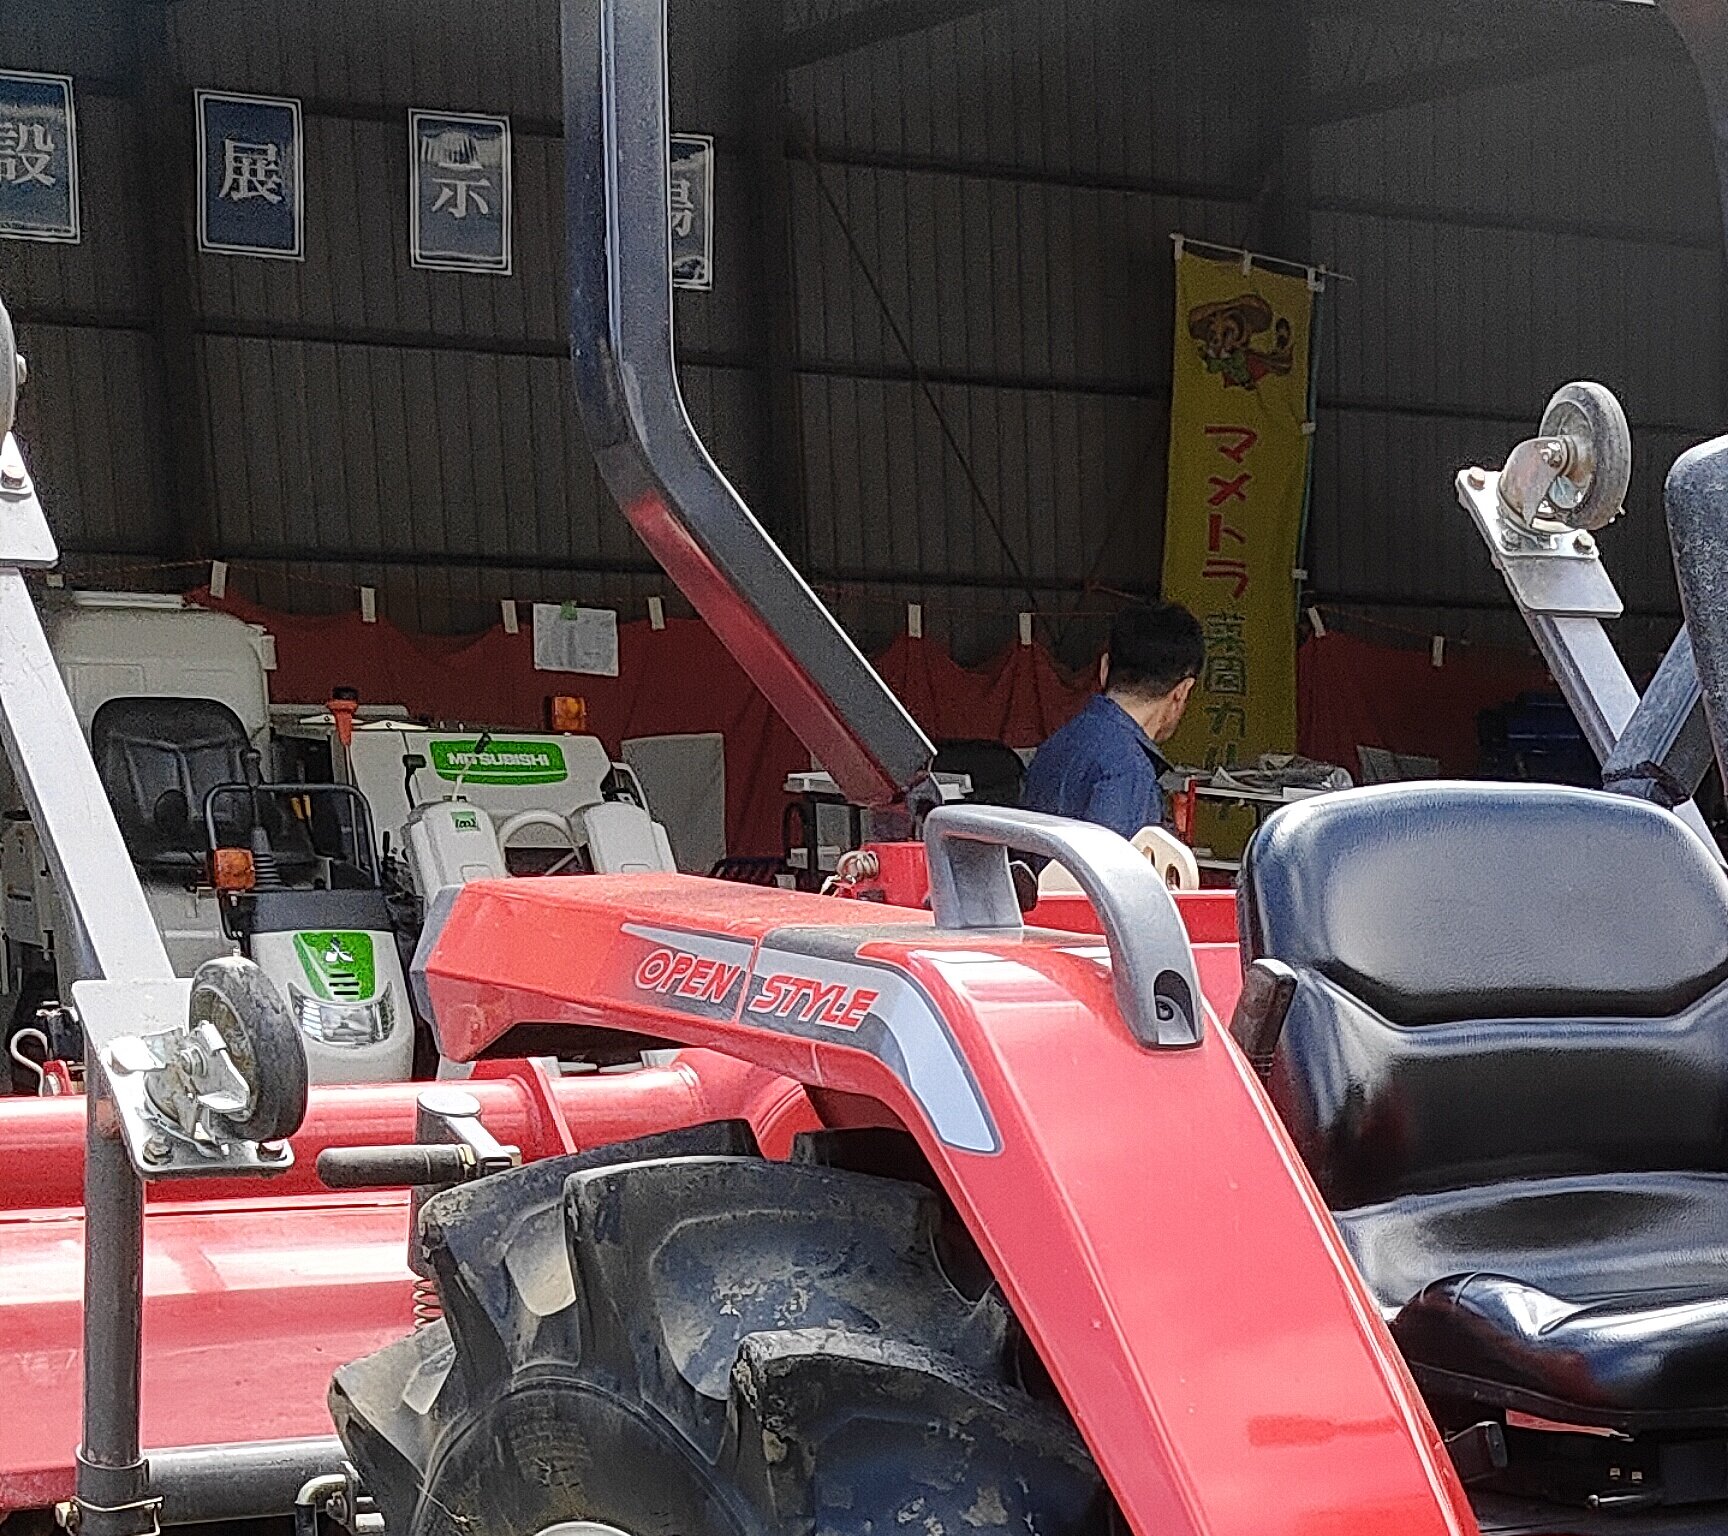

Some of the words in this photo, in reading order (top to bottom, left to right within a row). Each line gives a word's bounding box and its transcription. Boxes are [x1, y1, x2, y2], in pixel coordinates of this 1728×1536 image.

[219, 138, 283, 204] 展
[431, 161, 491, 218] 示
[1203, 425, 1258, 599] マメトラ
[635, 949, 741, 1003] OPEN
[747, 974, 880, 1032] STYLE
